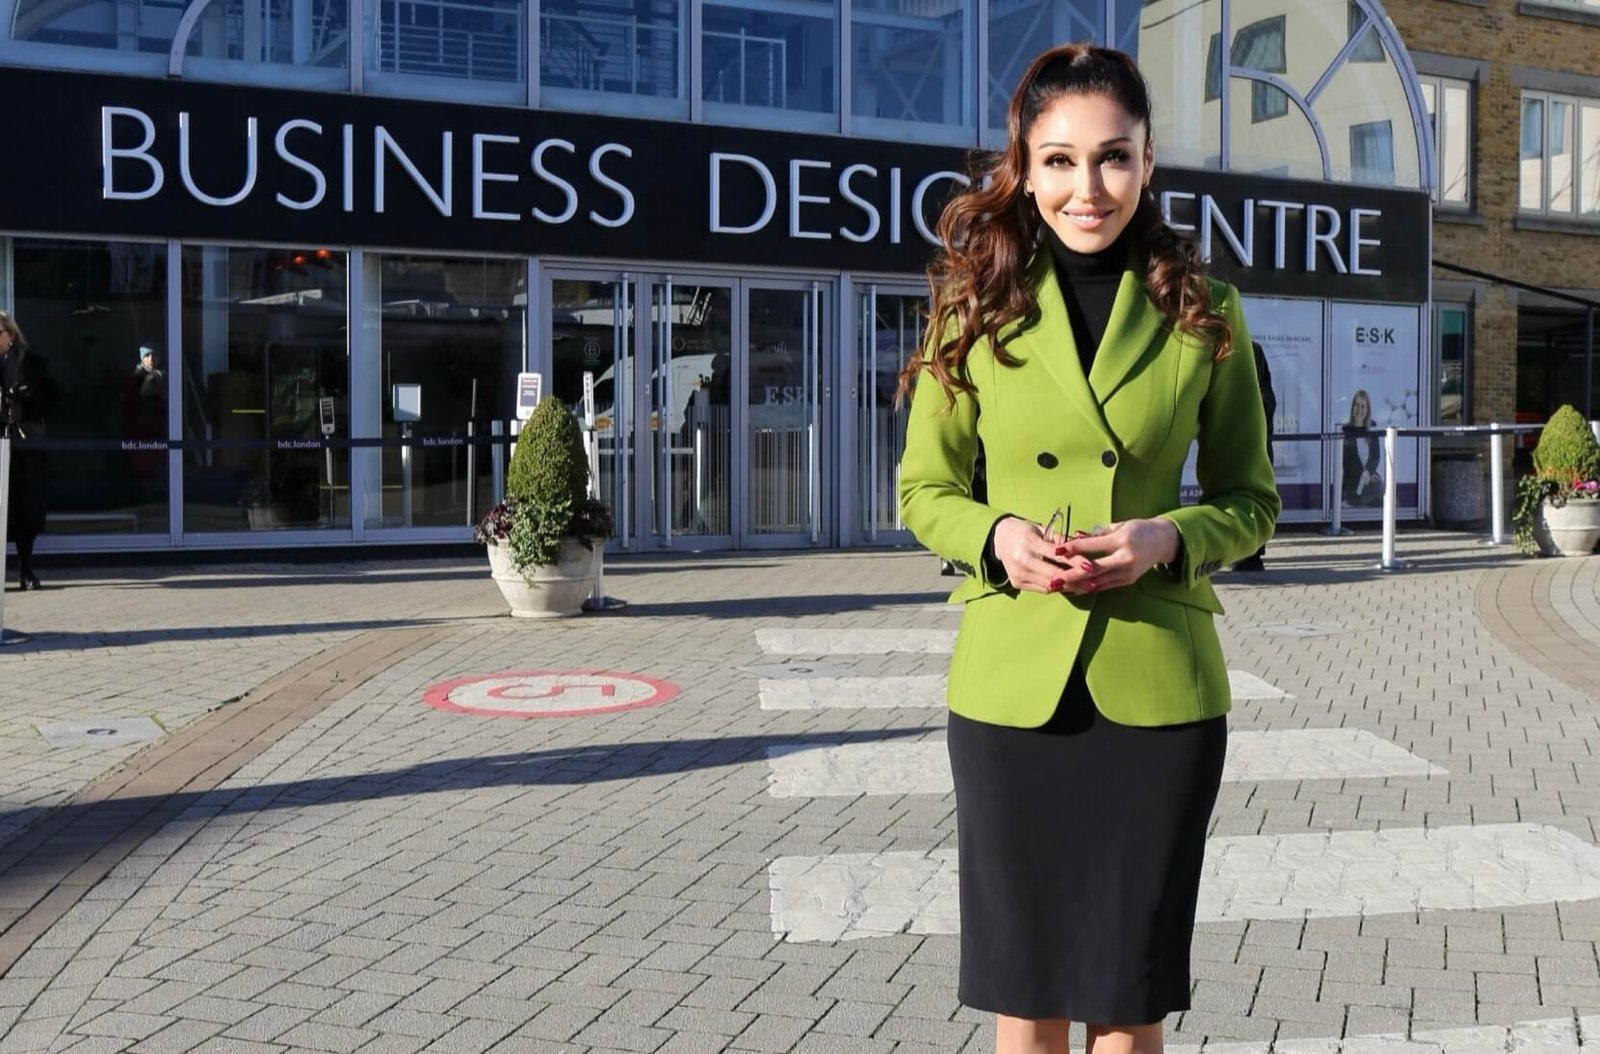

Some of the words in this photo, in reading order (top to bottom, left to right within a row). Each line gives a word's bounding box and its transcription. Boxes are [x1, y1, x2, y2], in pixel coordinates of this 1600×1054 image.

[101, 106, 635, 227] BUSINESS
[709, 152, 993, 247] DESIG
[1149, 191, 1382, 276] ENTRE
[121, 440, 168, 449] bdc.london
[277, 440, 321, 448] bdc.london
[423, 437, 464, 446] bdc.london
